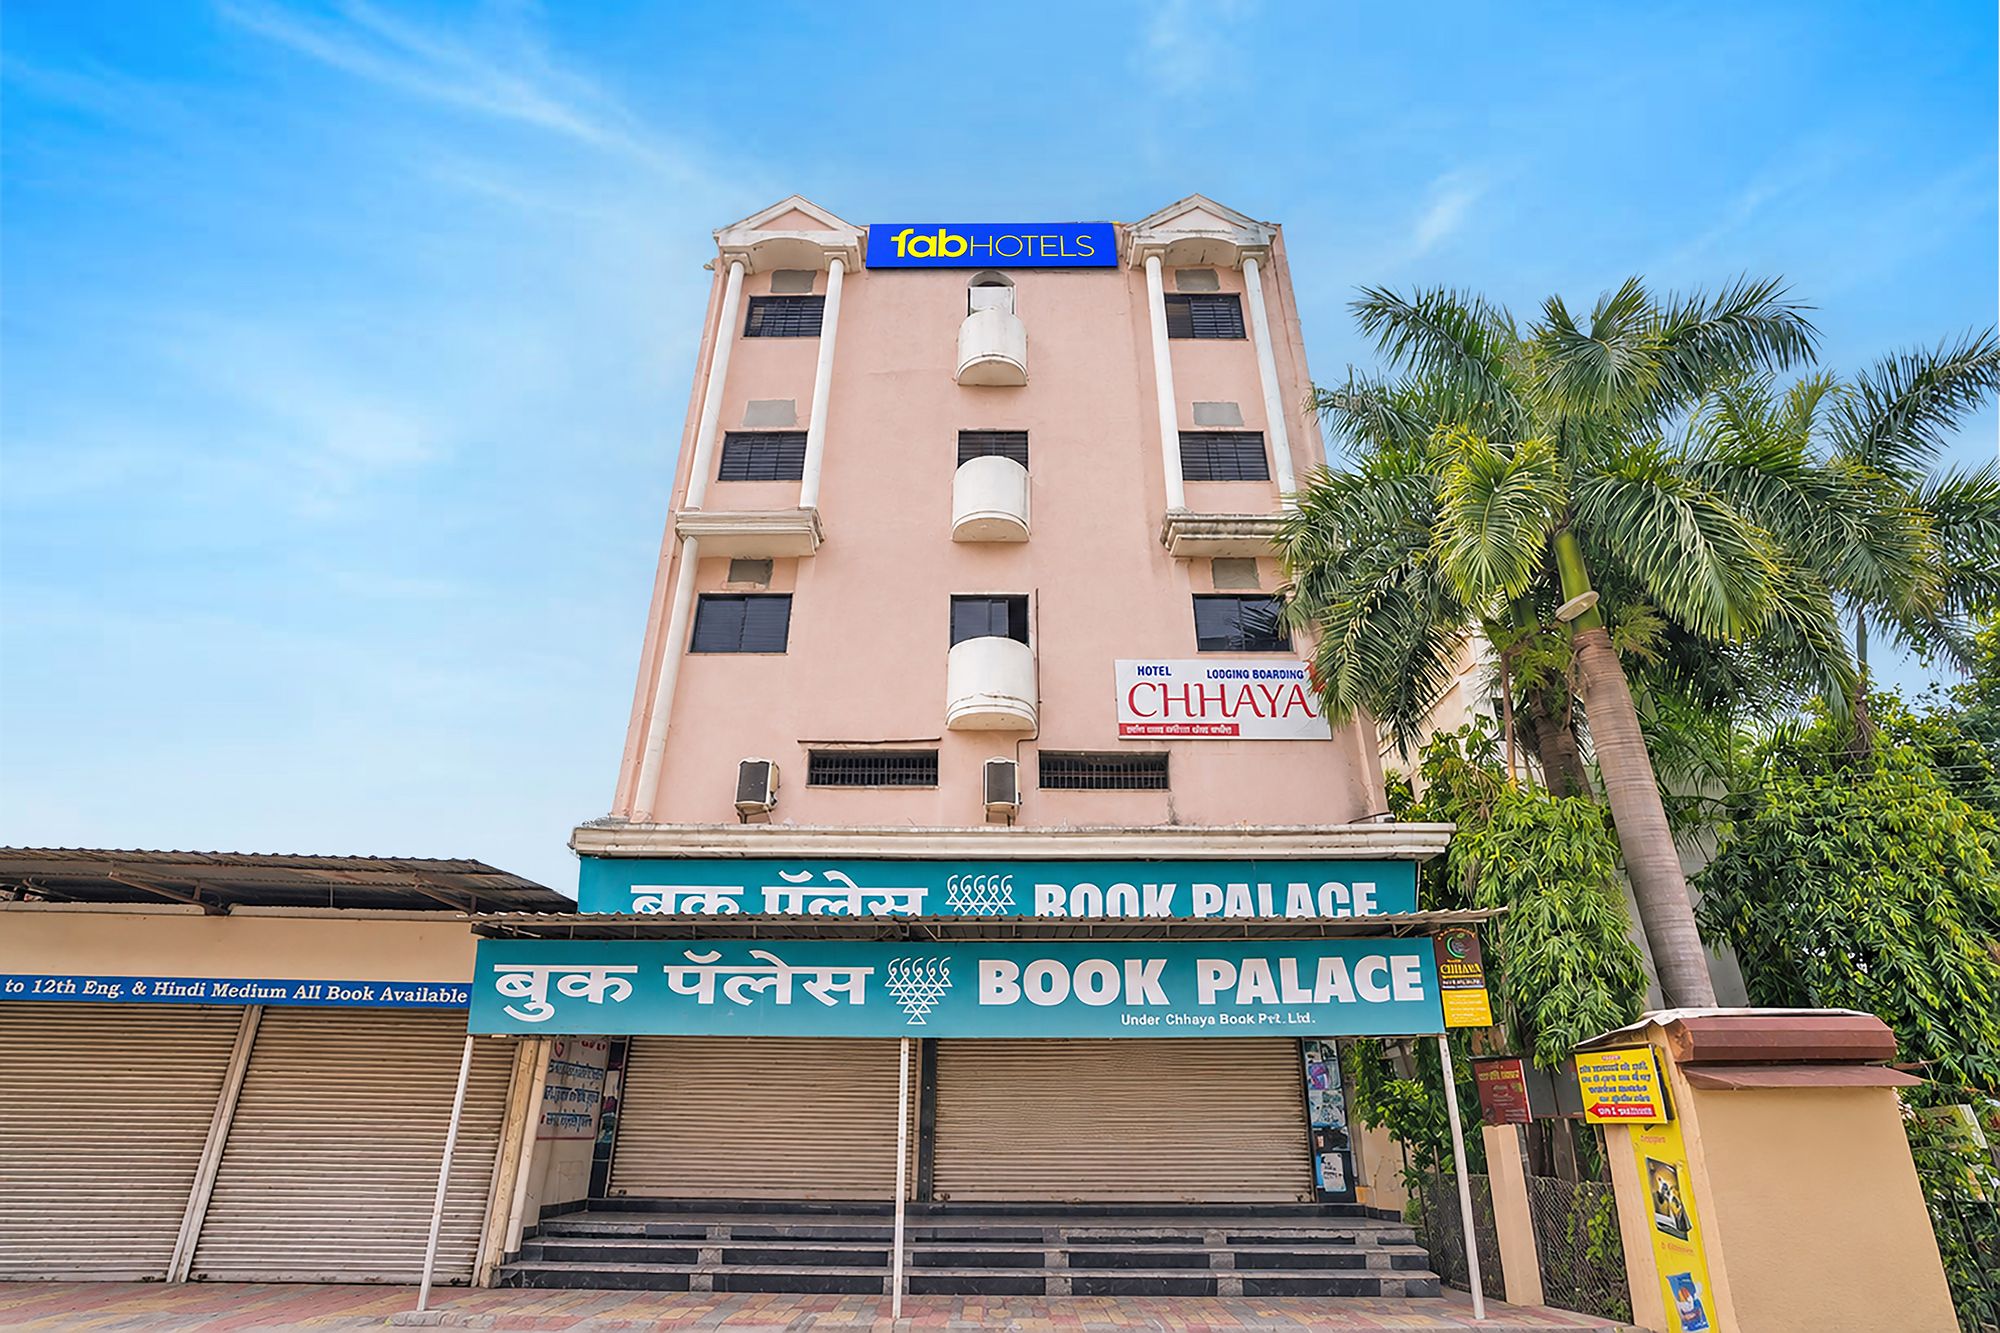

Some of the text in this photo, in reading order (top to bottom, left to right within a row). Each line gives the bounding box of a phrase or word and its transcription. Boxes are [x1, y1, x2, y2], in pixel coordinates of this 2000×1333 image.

[1137, 665, 1172, 677] HOTEL
[1206, 669, 1305, 680] LODGING BOARDING
[1128, 682, 1318, 718] CHHAYA
[1034, 881, 1377, 918] BOOK PALACE
[5, 979, 468, 1003] to 12th Eng. & Hindi Medium All Book Available
[494, 964, 639, 1023] बुक
[978, 954, 1425, 1006] BOOK PALACE
[1121, 1013, 1161, 1026] Under
[1165, 1013, 1216, 1028] Chhaya
[1219, 1013, 1254, 1025] Book
